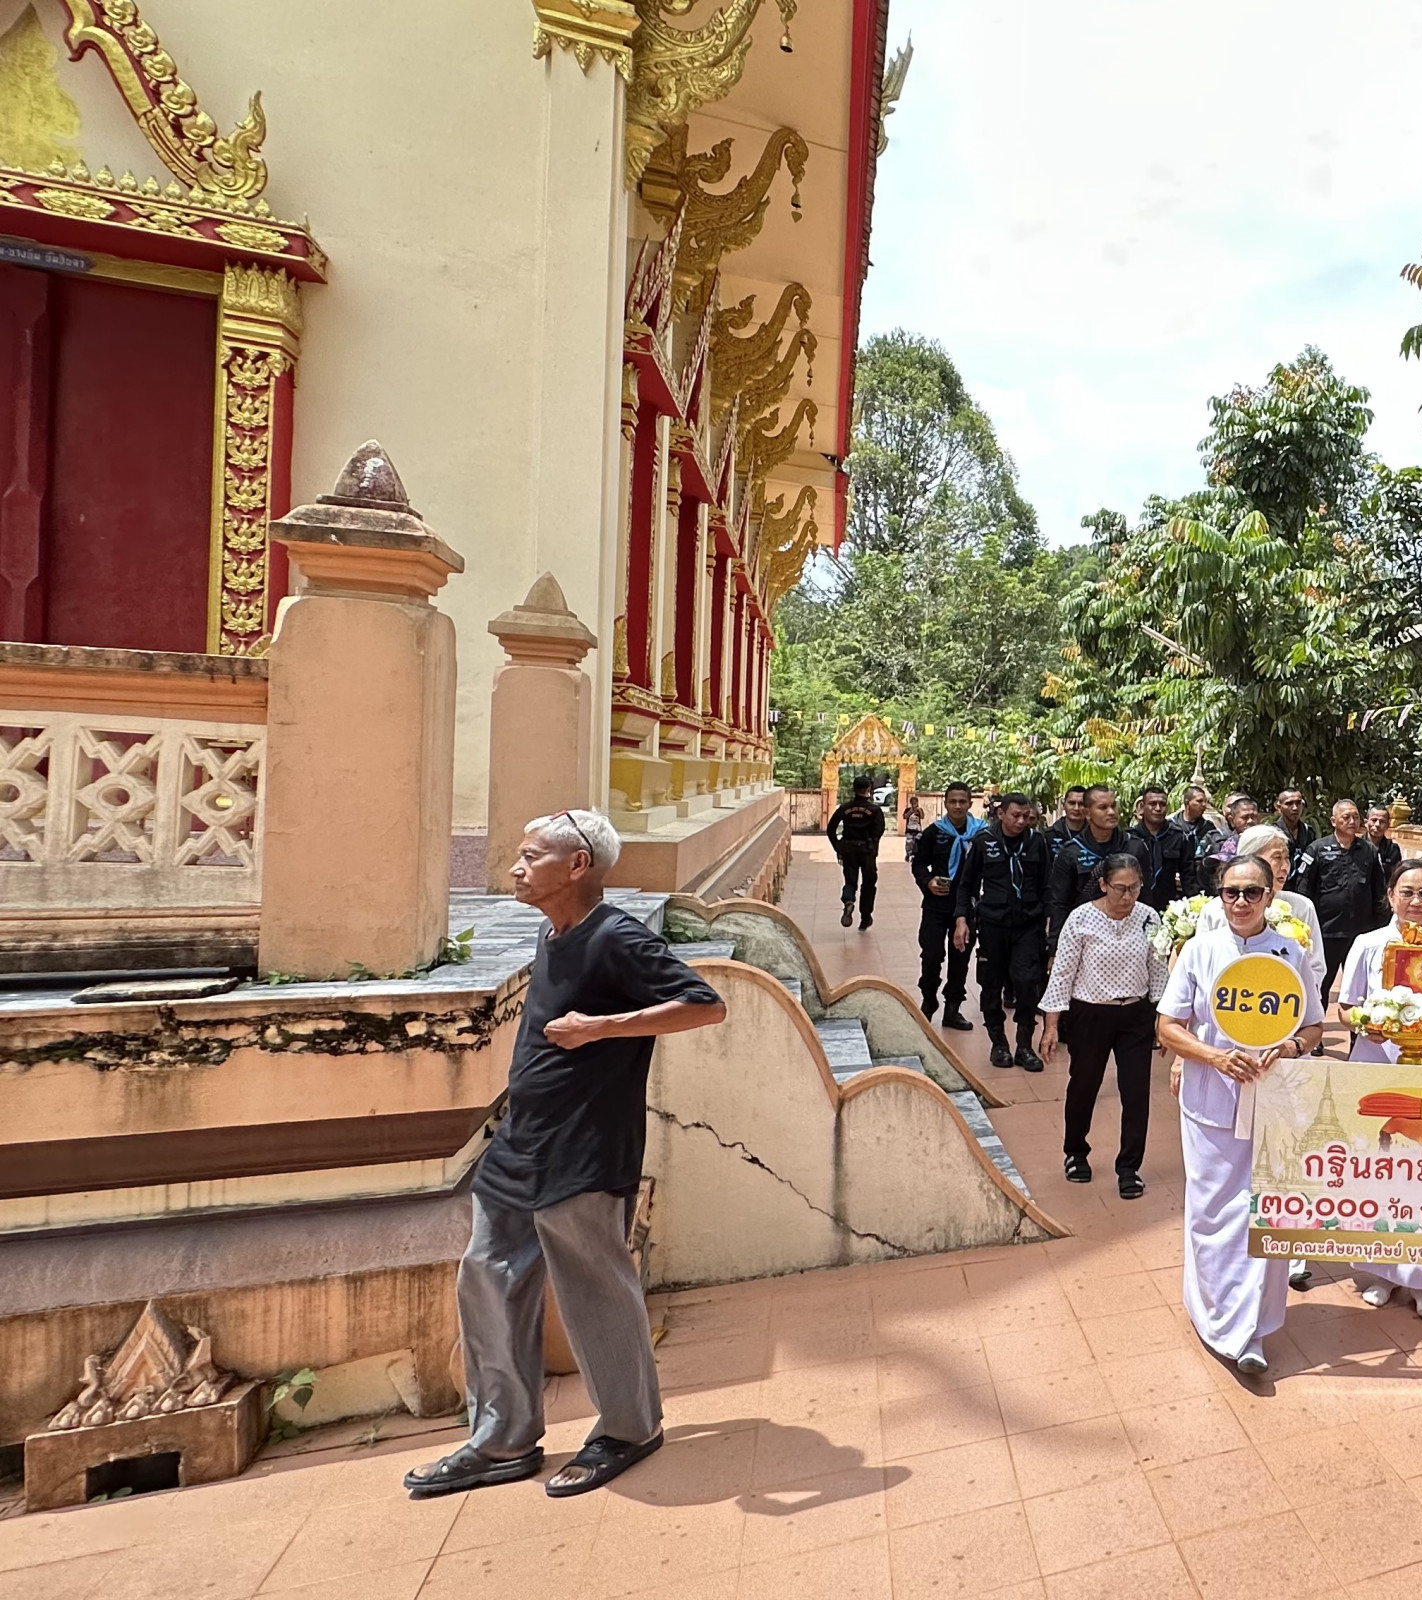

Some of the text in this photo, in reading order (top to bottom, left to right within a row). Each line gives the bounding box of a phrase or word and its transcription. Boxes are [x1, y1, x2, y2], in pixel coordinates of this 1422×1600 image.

[1216, 986, 1300, 1018] ยะลา
[1261, 1195, 1379, 1221] ๓๐,๐๐๐
[1387, 1197, 1413, 1220] วัด
[1263, 1237, 1289, 1253] โดย
[1294, 1241, 1402, 1261] คณะศิษยานุศิษย์
